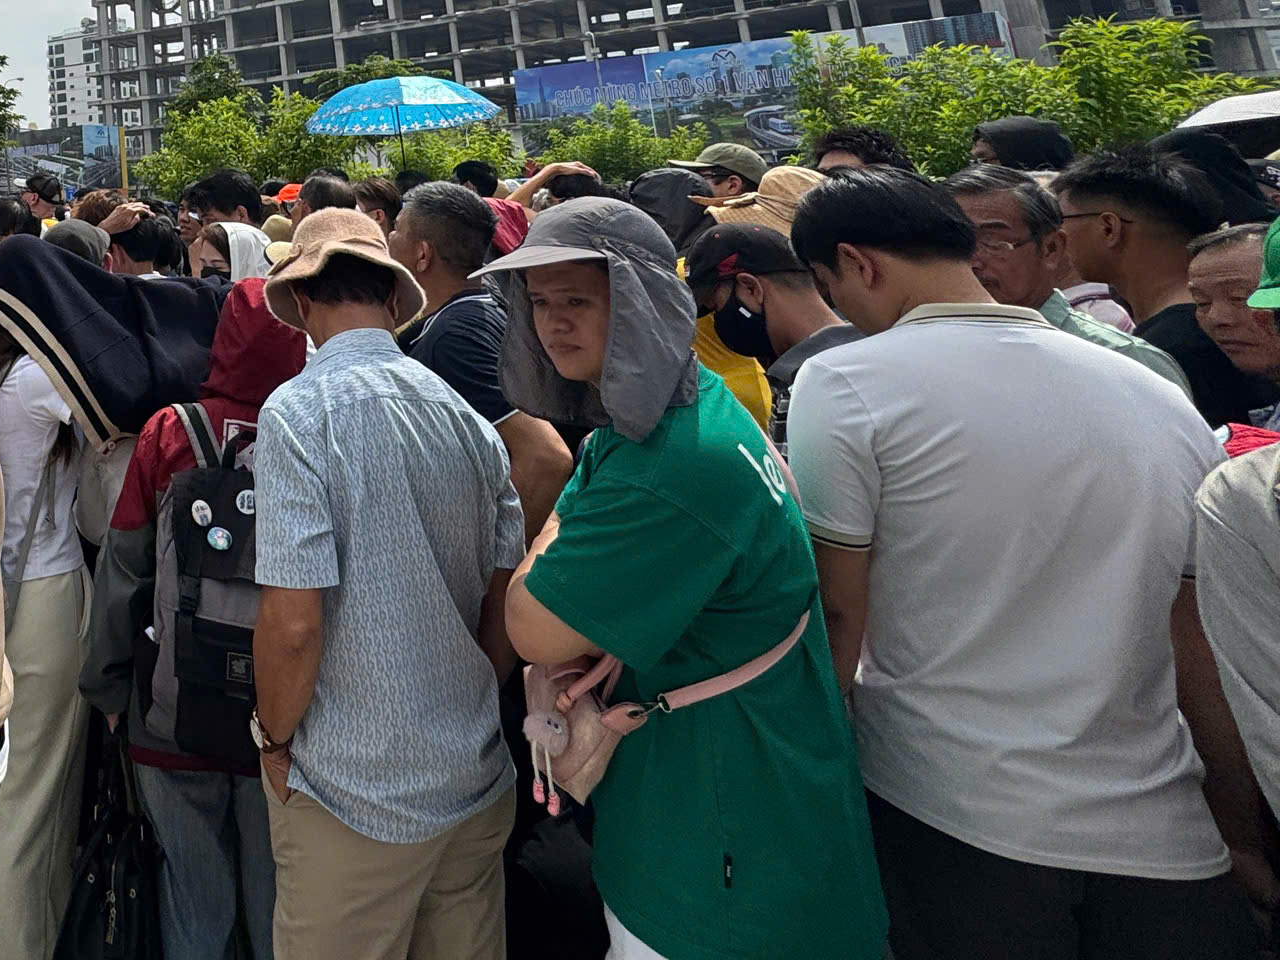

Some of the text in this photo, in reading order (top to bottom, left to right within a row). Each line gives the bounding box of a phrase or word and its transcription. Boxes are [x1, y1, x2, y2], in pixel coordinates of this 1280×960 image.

[555, 85, 593, 107] CHÚC
[639, 77, 692, 101] METRO
[721, 73, 731, 93] 1
